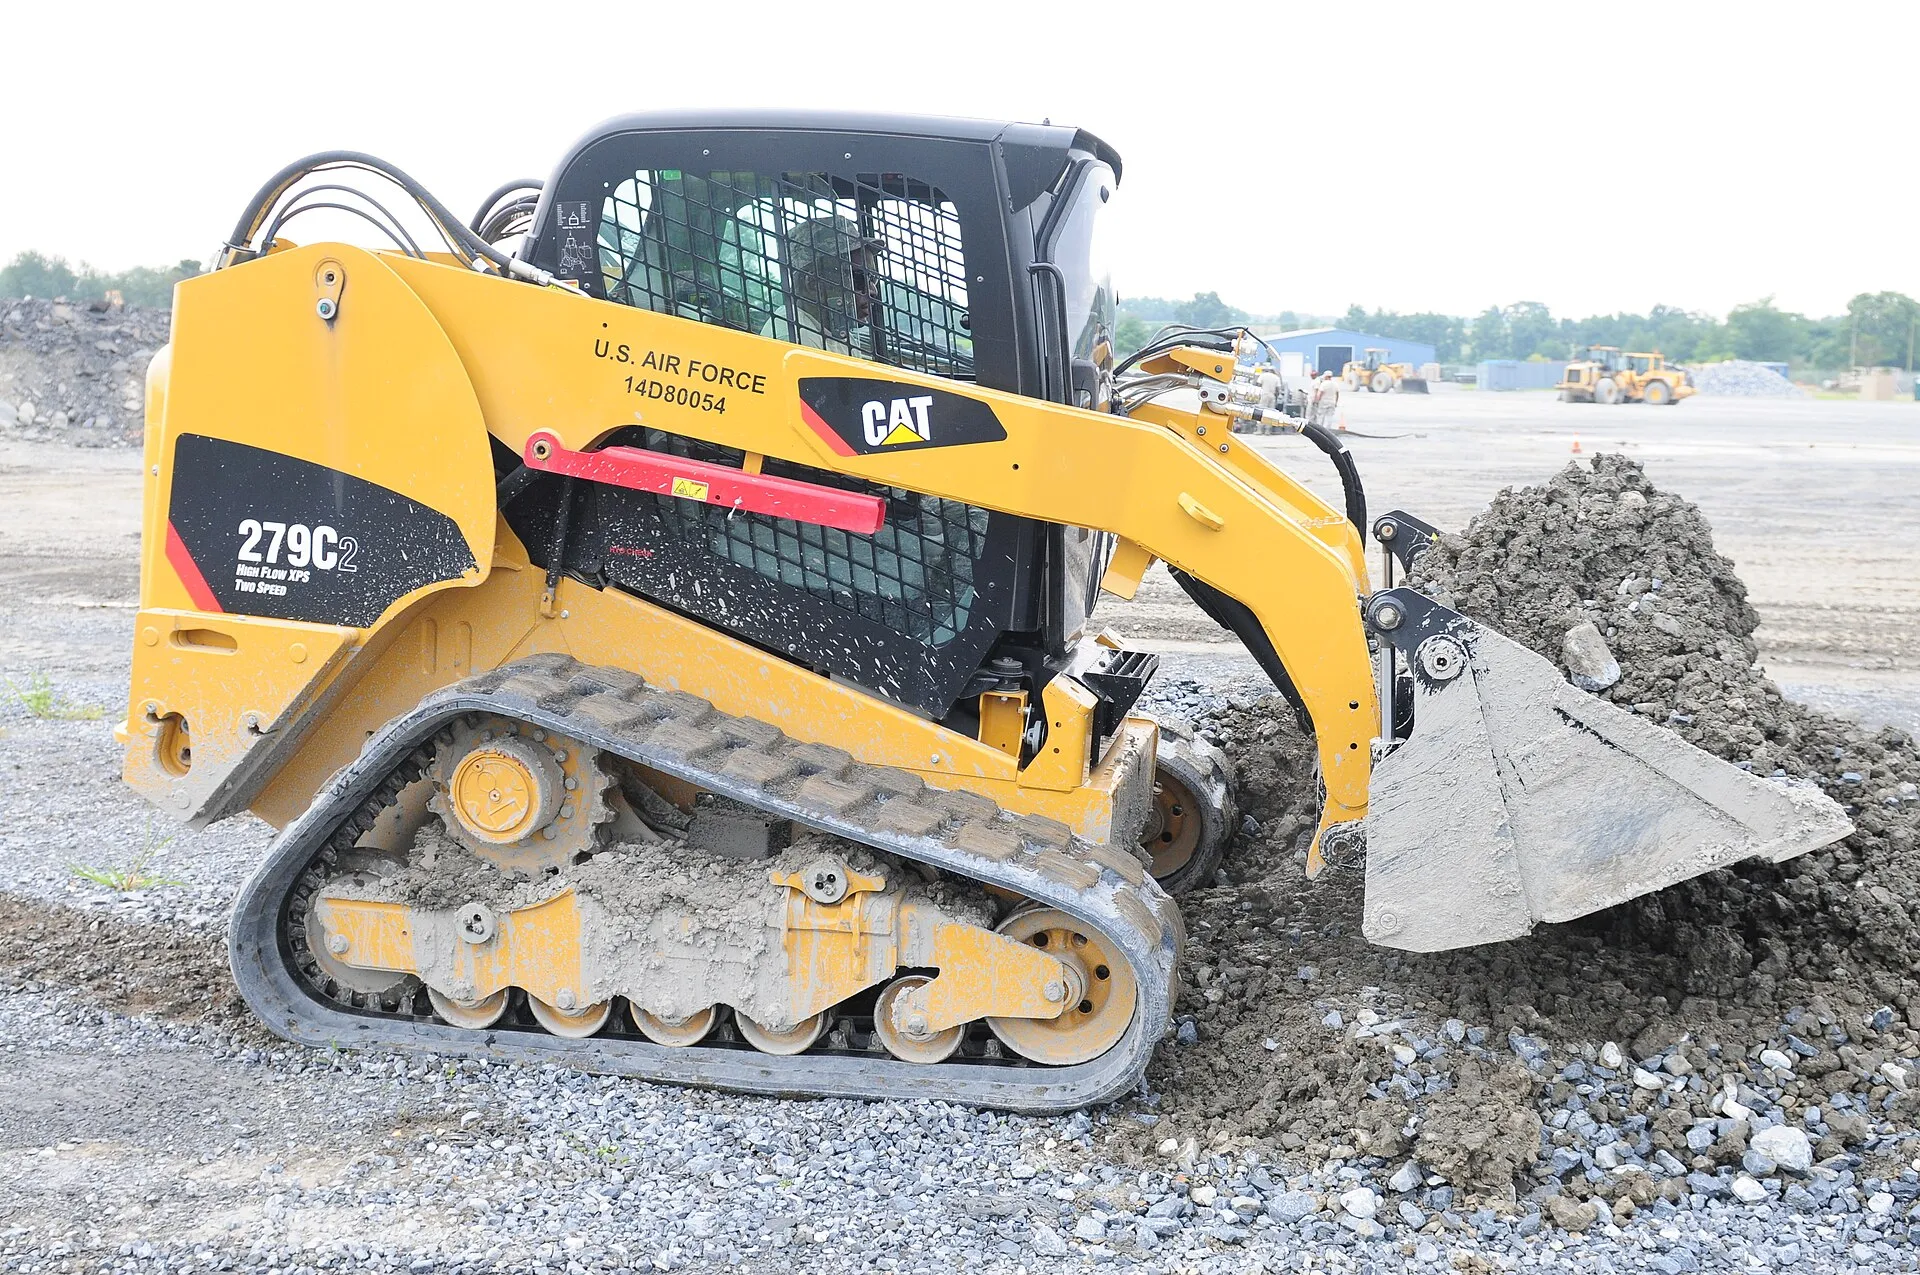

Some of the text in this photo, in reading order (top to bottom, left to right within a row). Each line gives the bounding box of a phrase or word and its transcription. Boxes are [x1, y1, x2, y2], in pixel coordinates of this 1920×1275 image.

[594, 339, 767, 394] U.S. AIR FORCE
[624, 376, 726, 415] 14D80054
[861, 395, 933, 447] CAT
[287, 569, 311, 583] XPS
